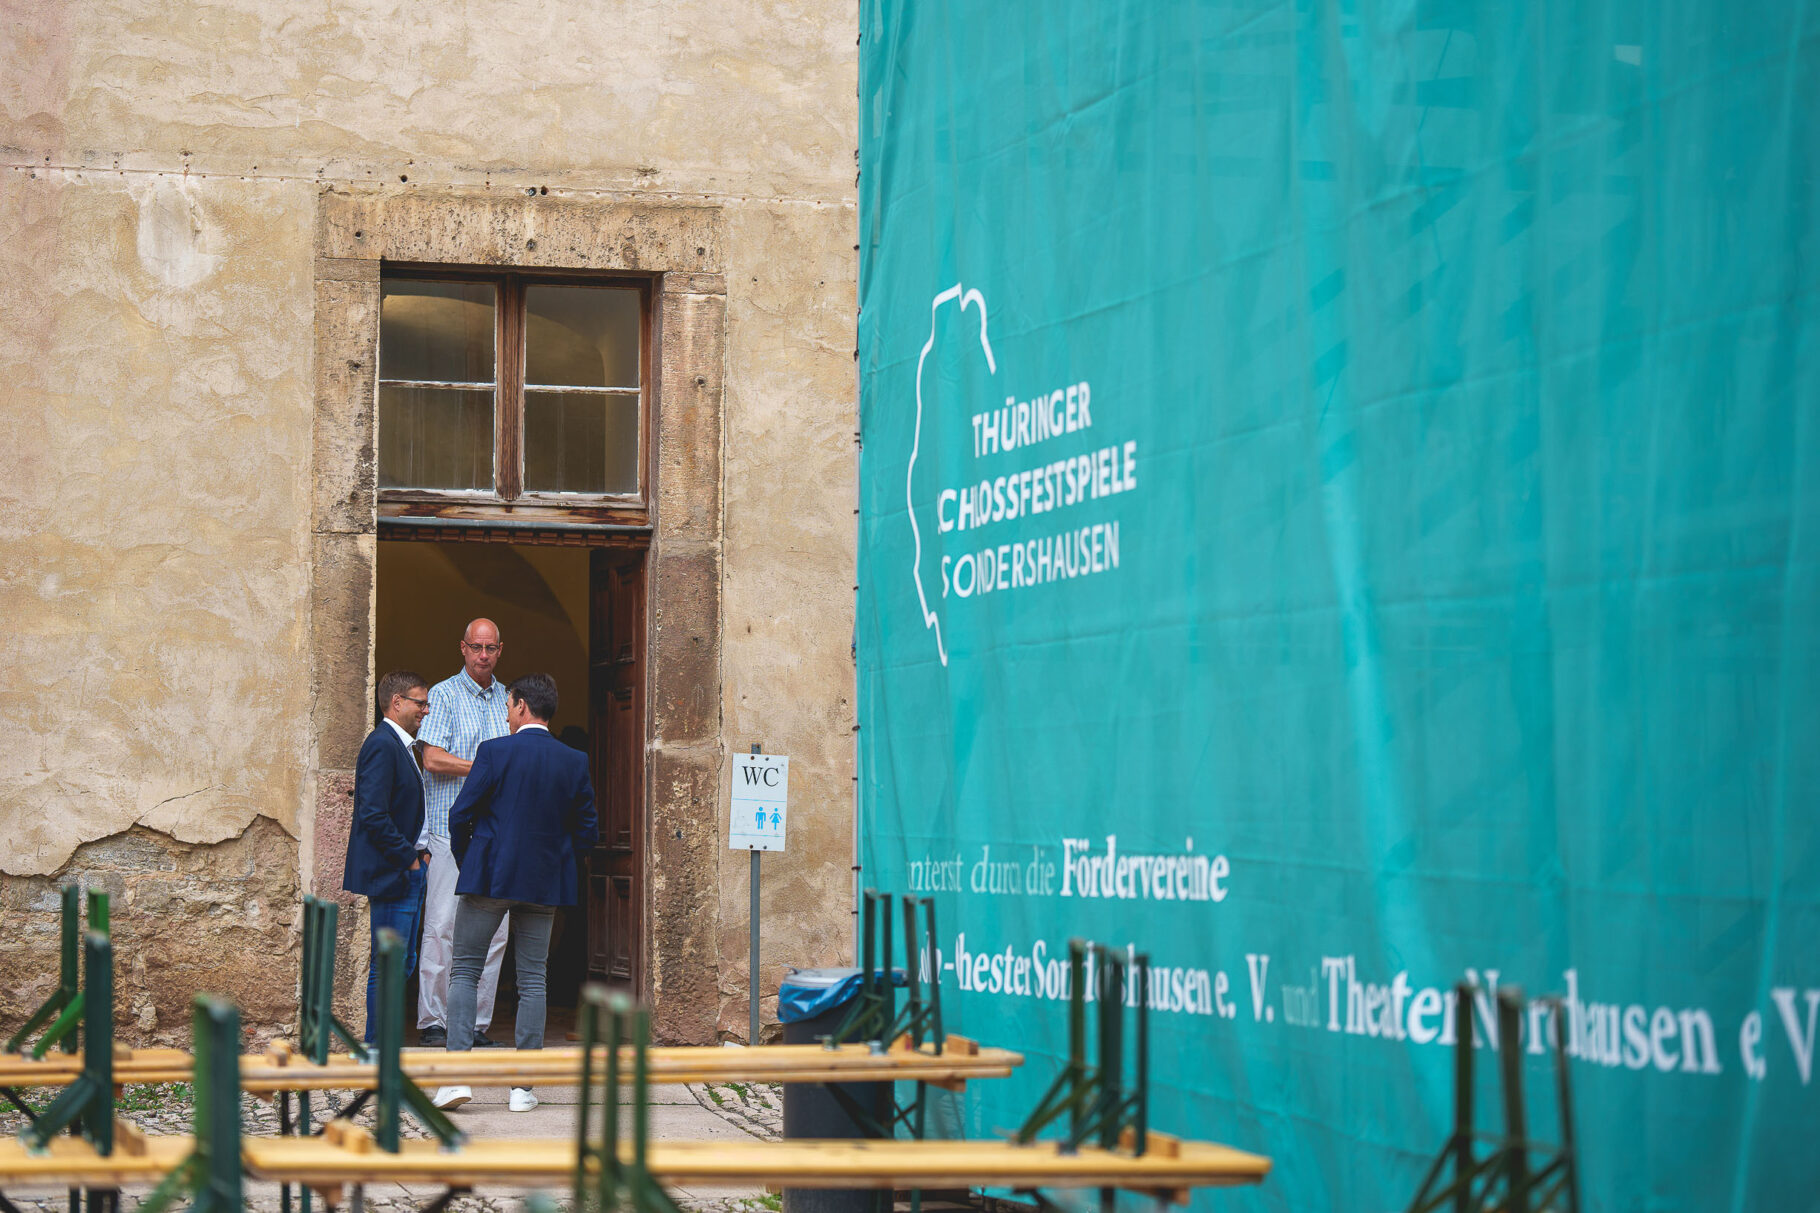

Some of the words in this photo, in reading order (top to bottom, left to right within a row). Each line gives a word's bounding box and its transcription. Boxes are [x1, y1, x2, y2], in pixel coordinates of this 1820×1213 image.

[972, 381, 1092, 458] THÜRINGER
[936, 440, 1137, 535] CHLOSSFESTSPIELE
[941, 521, 1120, 598] SONDERSHAUSEN
[742, 766, 779, 787] WC
[1026, 844, 1056, 896] die
[1059, 834, 1230, 902] Fördervereine
[1245, 953, 1274, 1023] V.
[1463, 967, 1723, 1075] Nrdhausen
